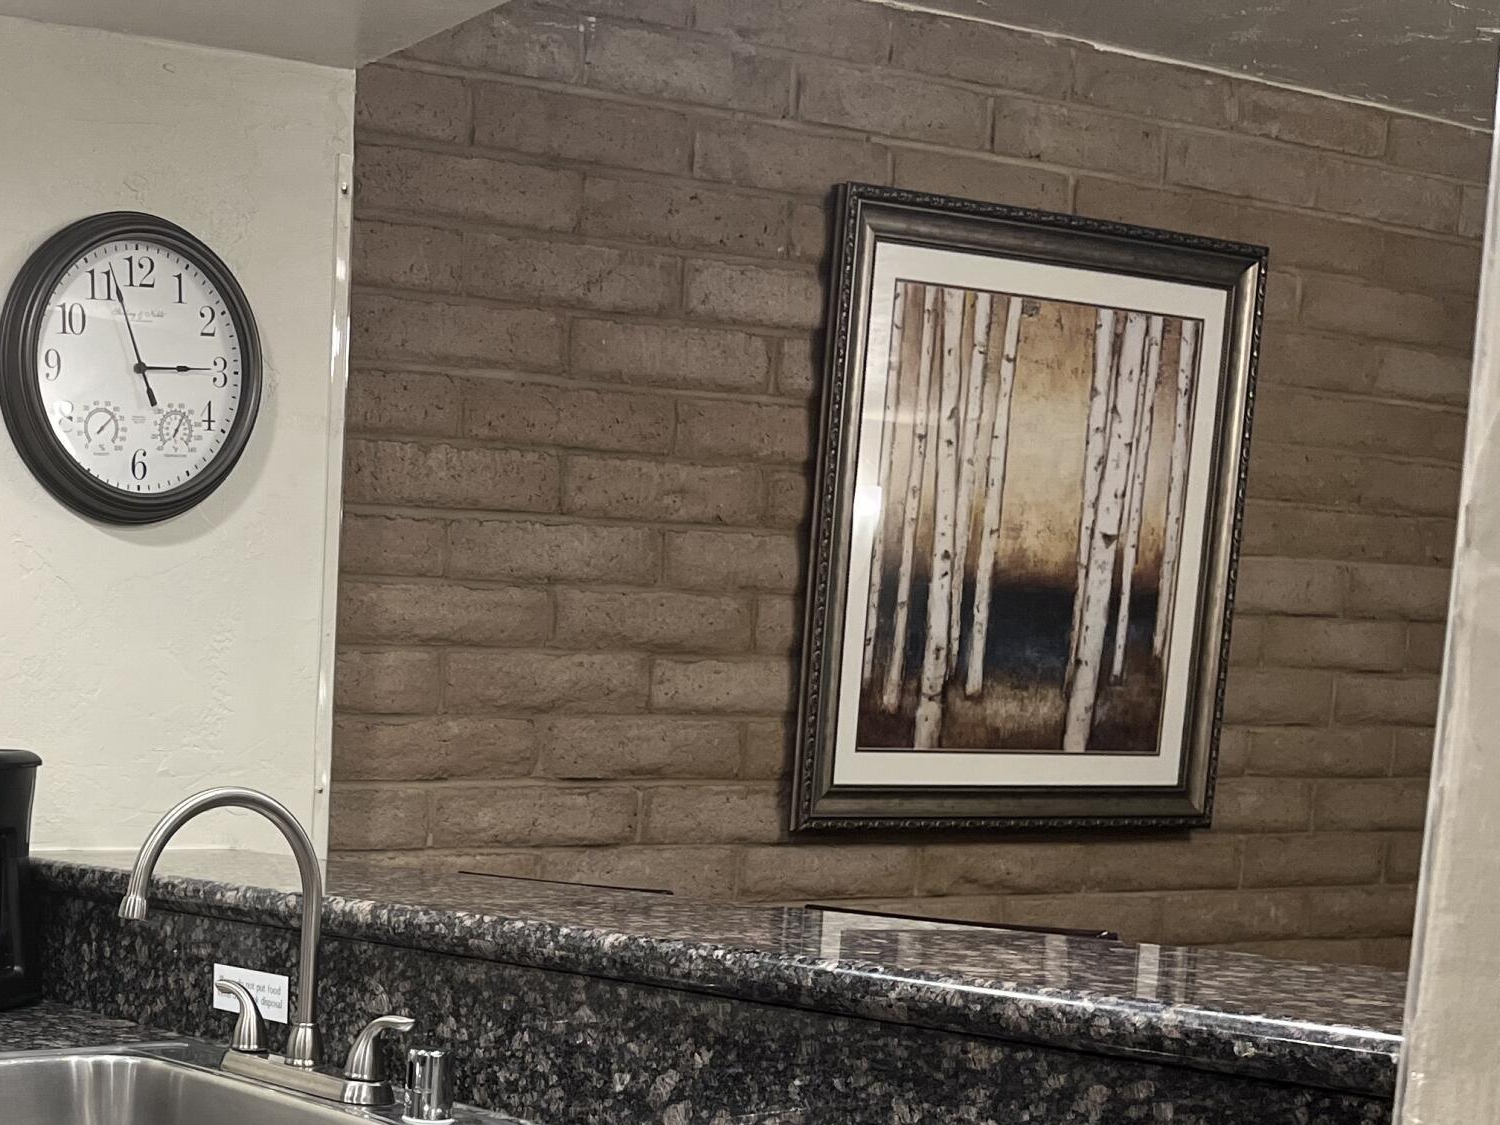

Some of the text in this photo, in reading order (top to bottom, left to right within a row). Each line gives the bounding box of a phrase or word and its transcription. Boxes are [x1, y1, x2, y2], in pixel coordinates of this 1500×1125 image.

[86, 269, 117, 302] 11
[123, 255, 156, 289] 12
[172, 272, 188, 305] 1
[56, 302, 86, 336] 10
[199, 305, 217, 338] 2
[44, 348, 62, 382] 9
[212, 356, 228, 389] 3
[201, 400, 217, 432] 4
[130, 448, 148, 481] 6
[256, 984, 266, 994] put
[267, 984, 281, 995] food
[260, 997, 283, 1009] disposal
